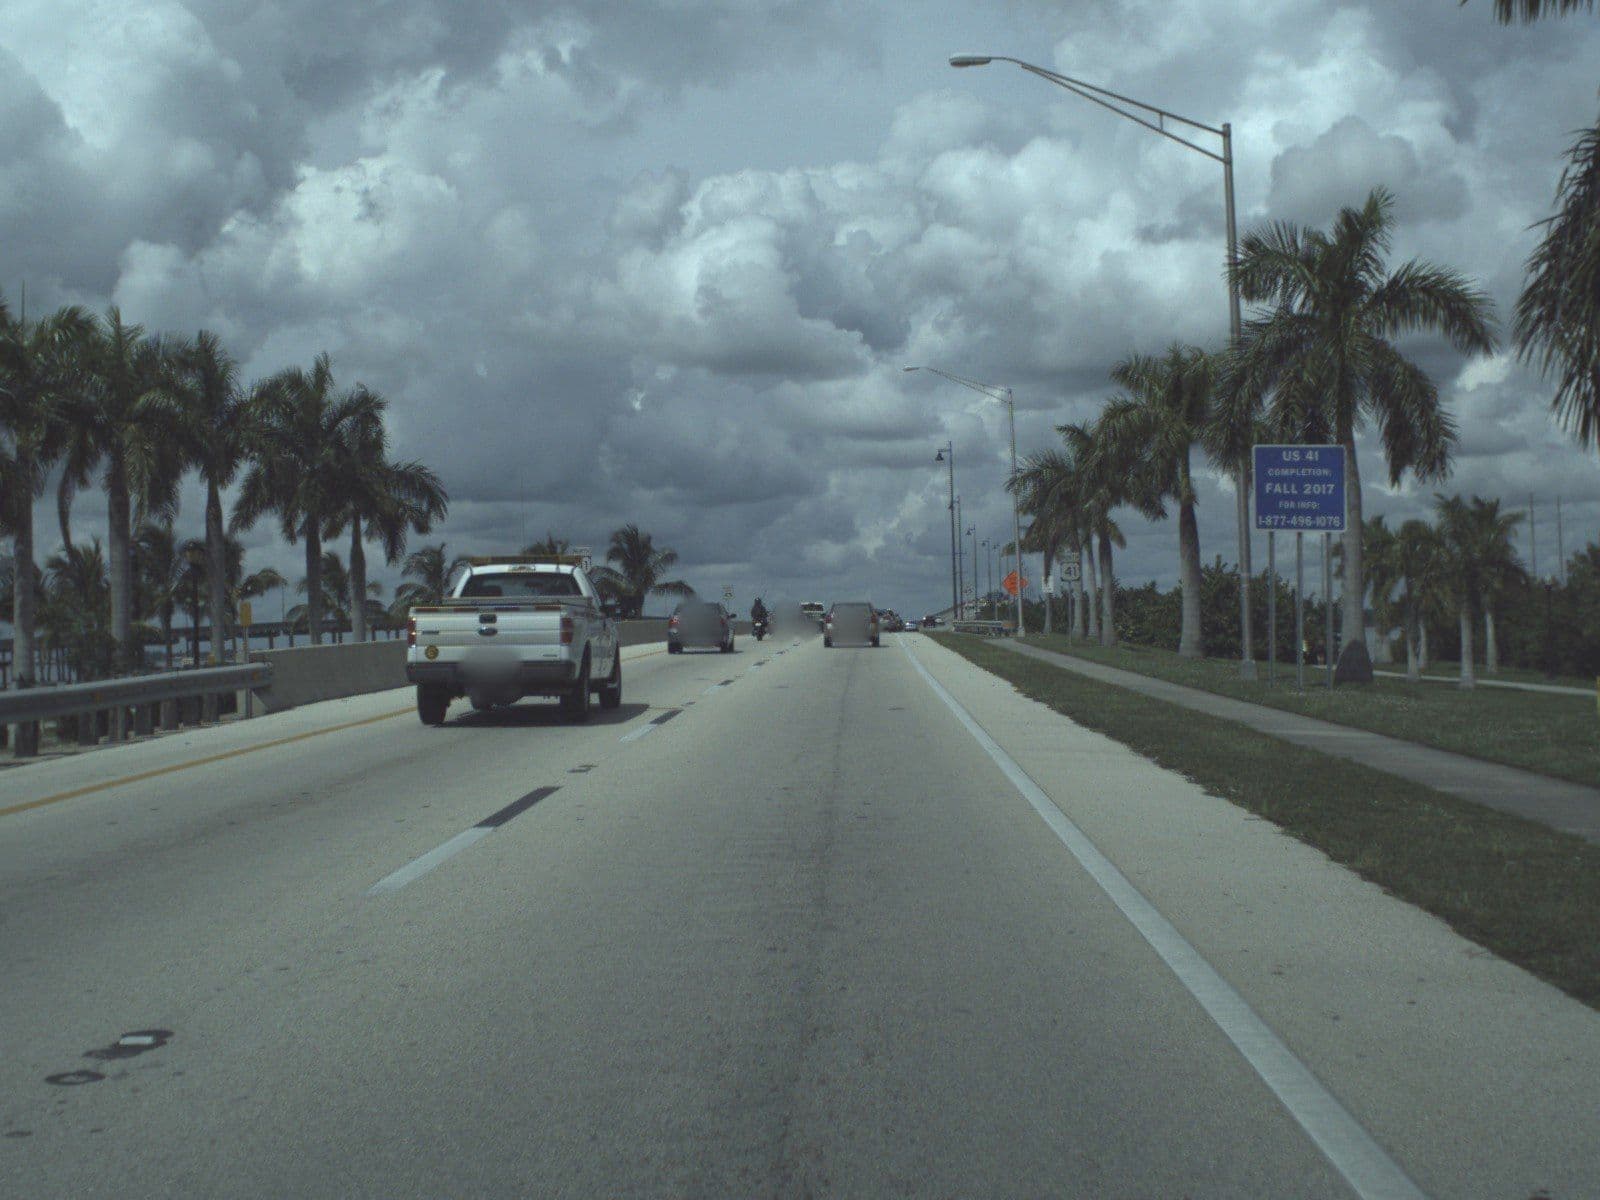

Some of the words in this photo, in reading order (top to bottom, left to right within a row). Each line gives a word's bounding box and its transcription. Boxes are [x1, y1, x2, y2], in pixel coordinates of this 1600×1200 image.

[1282, 450, 1300, 461] US
[1305, 450, 1319, 461] 41
[1266, 484, 1298, 494] FALL
[1303, 483, 1335, 494] 2017
[1278, 500, 1295, 509] FOR
